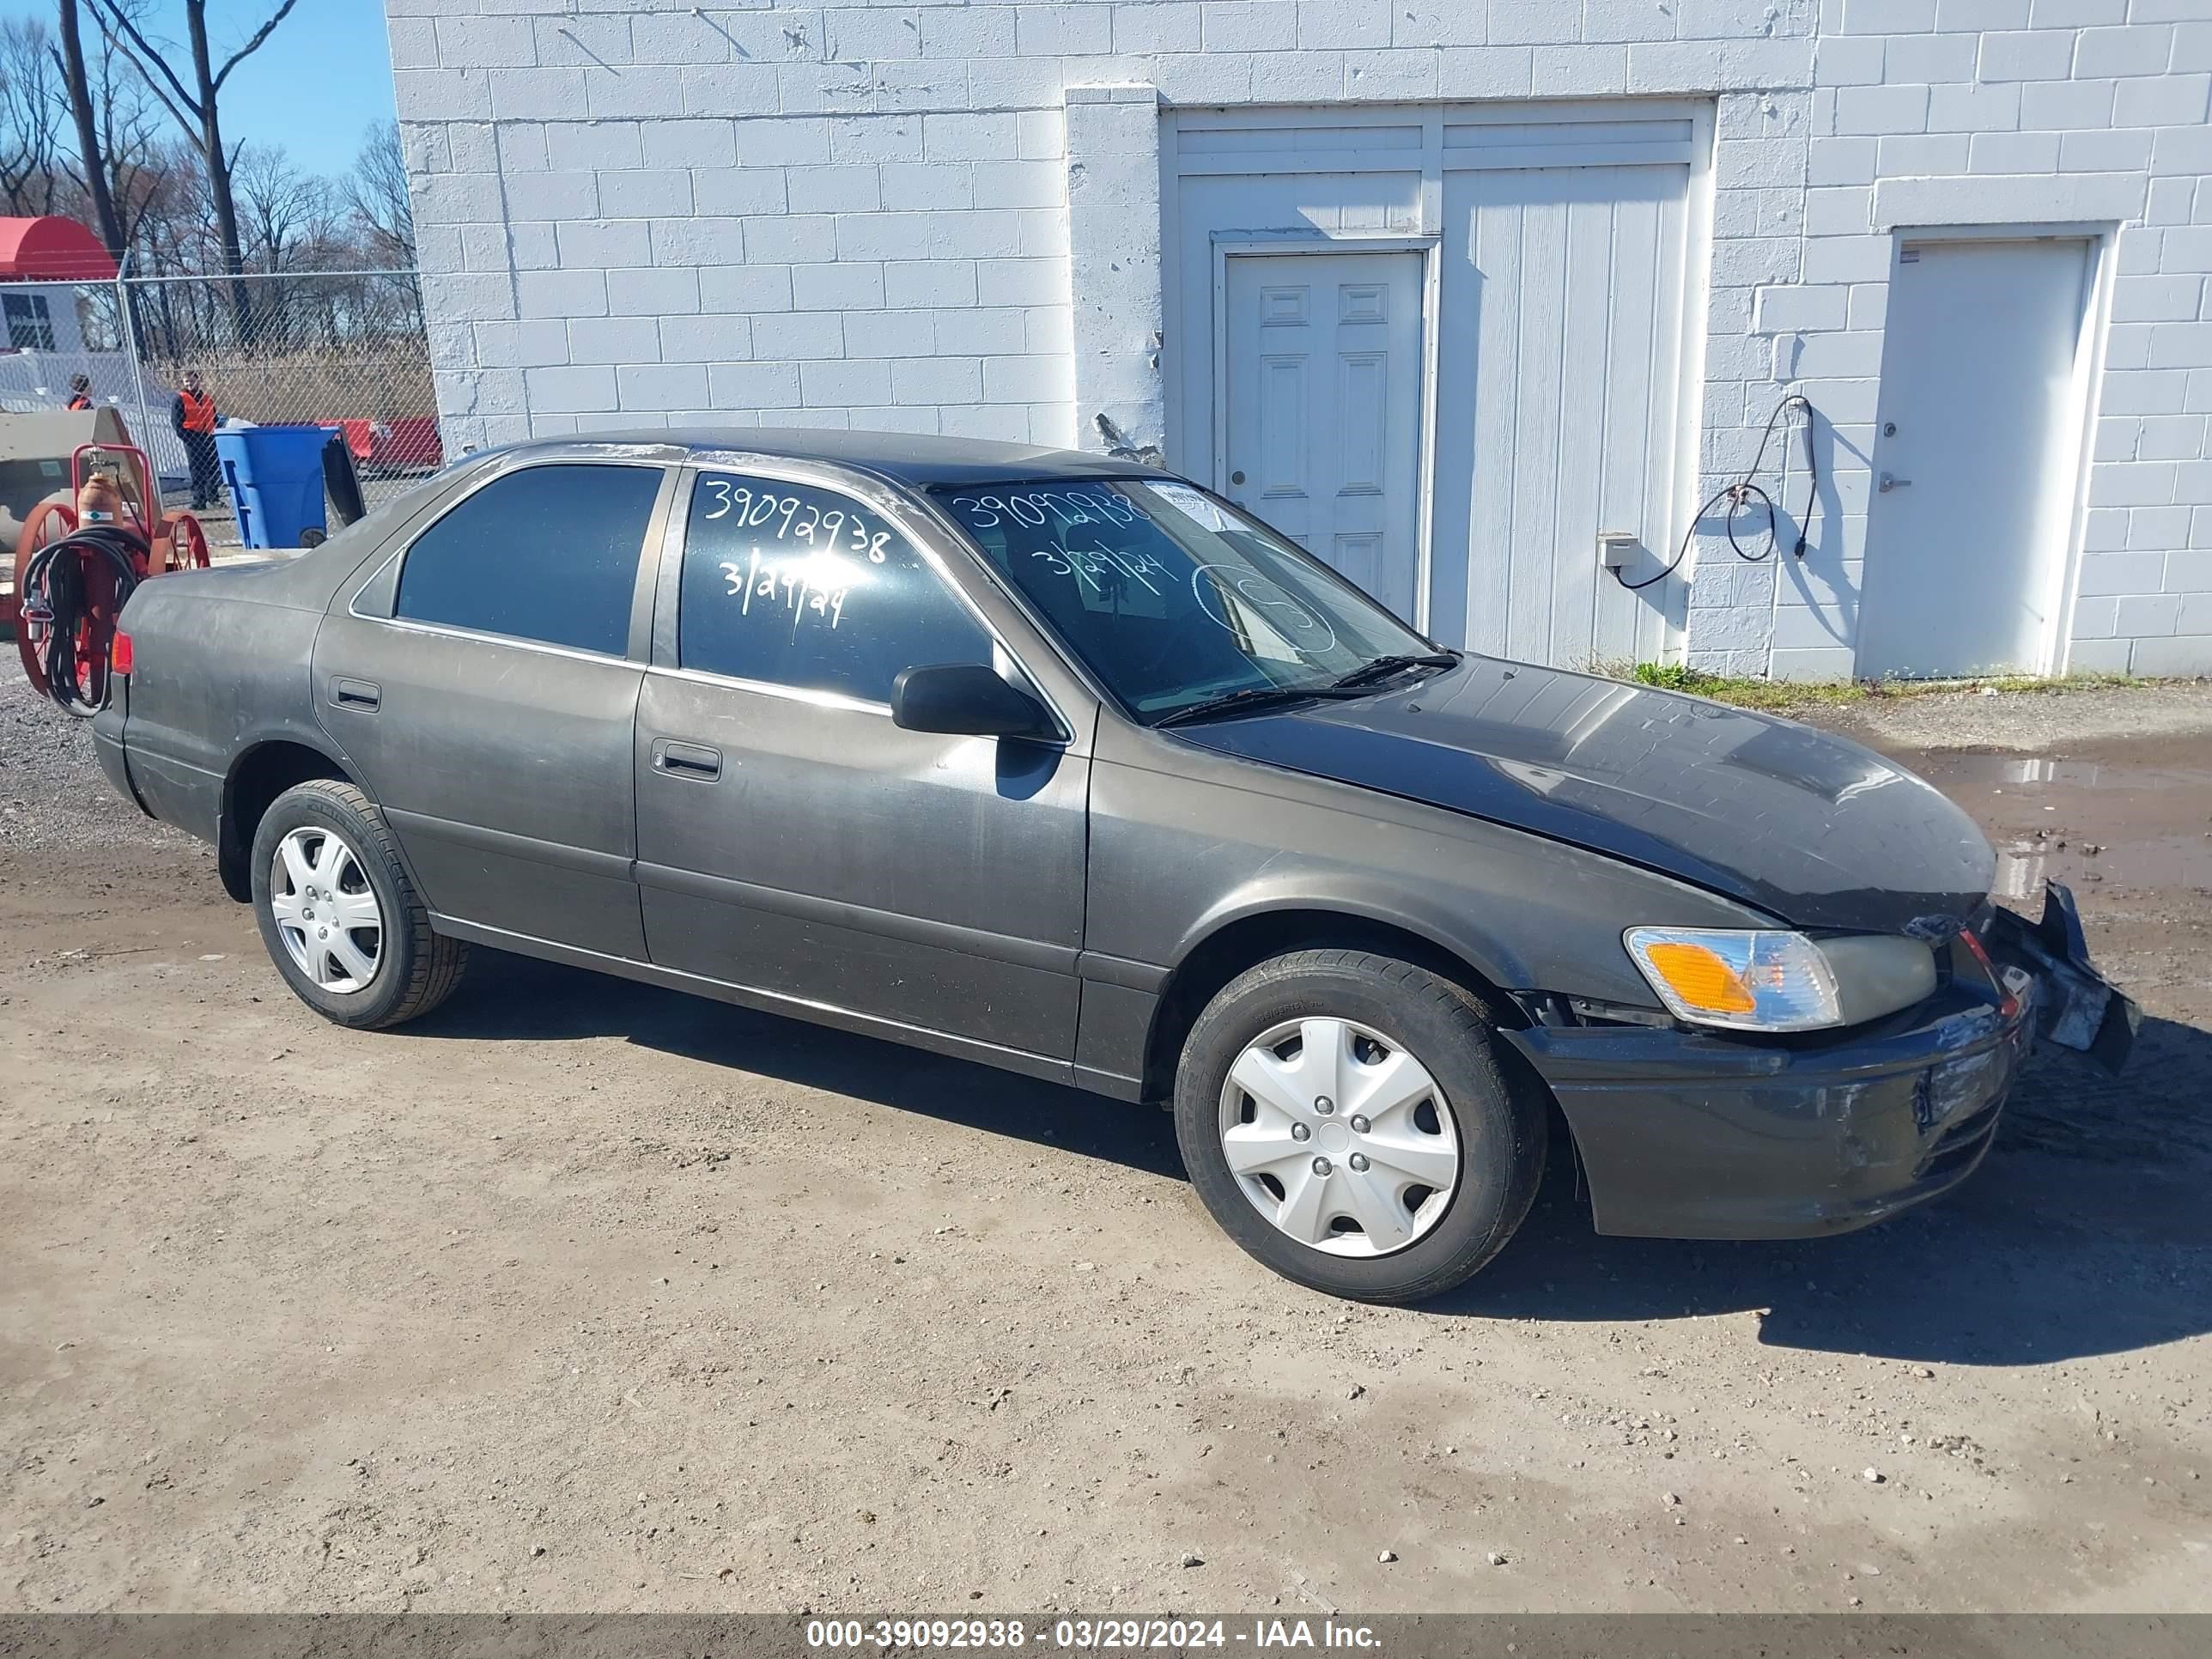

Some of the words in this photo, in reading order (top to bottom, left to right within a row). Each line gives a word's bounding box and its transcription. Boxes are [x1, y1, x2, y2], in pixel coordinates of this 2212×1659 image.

[706, 481, 891, 563] 39092938
[953, 492, 1152, 529] 39092938
[1031, 540, 1181, 596] 3/29/24
